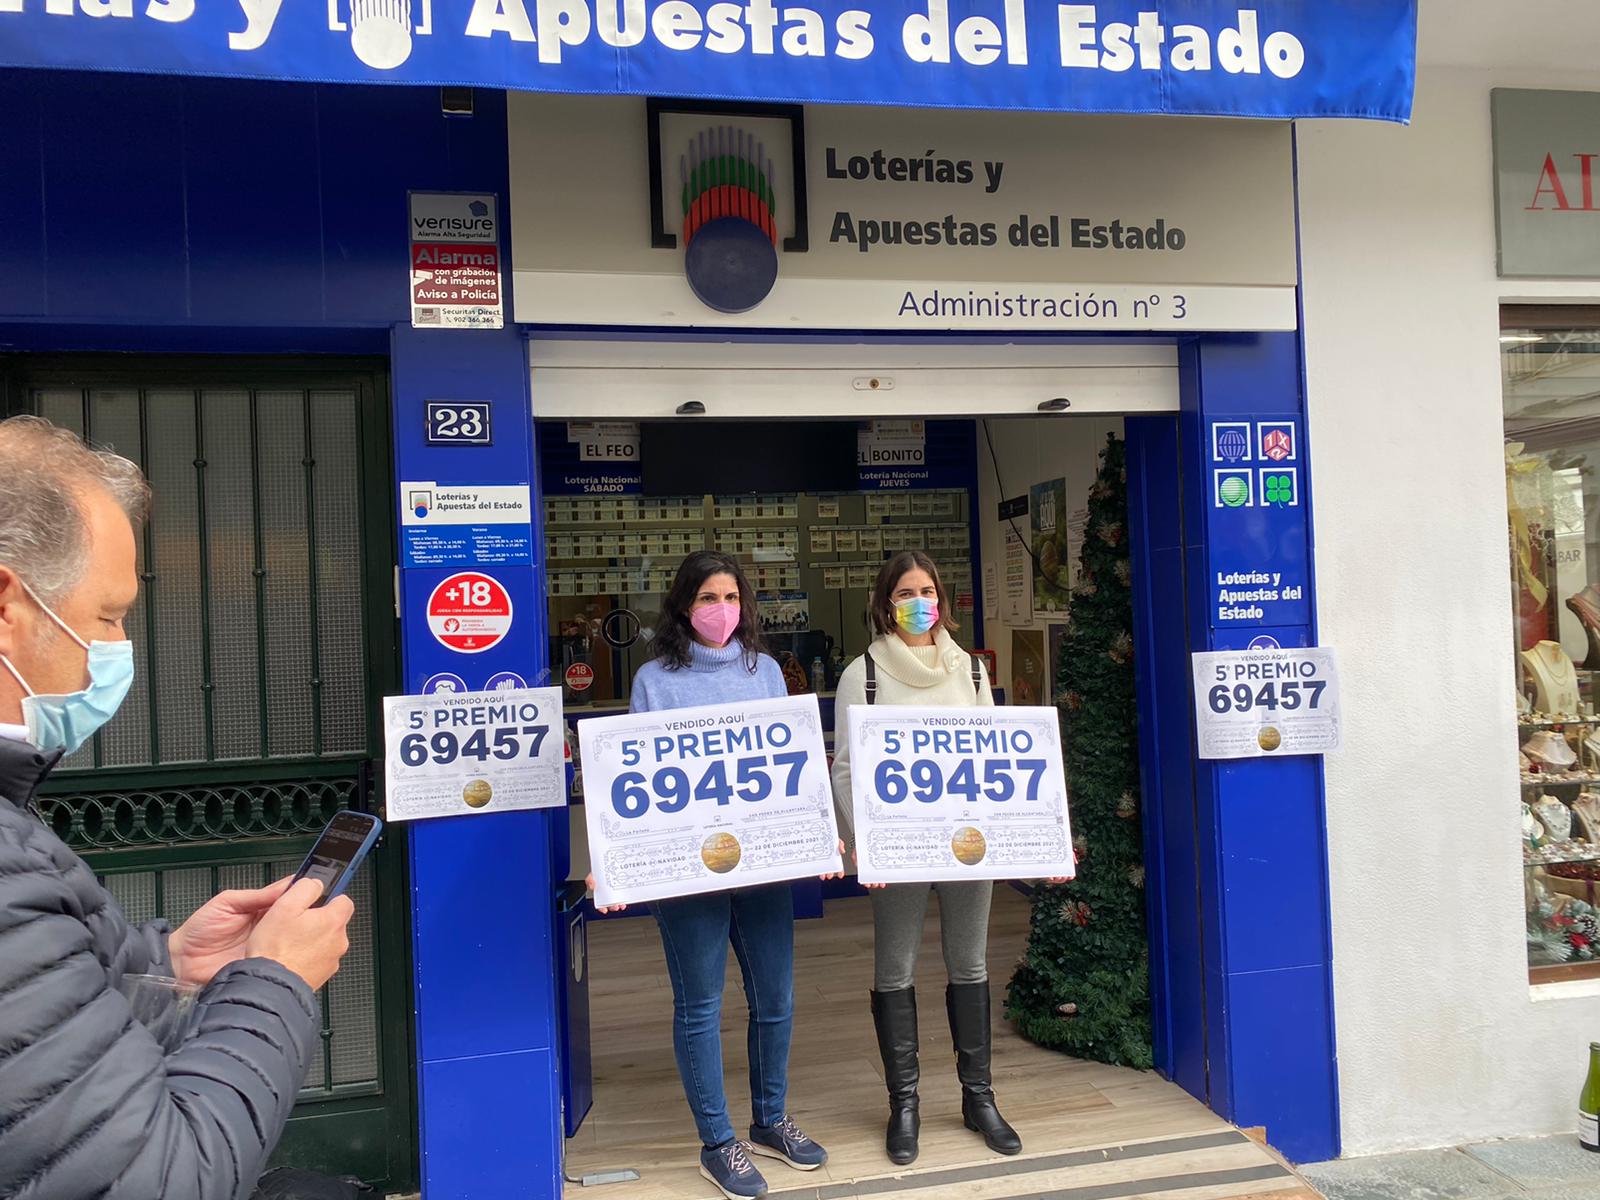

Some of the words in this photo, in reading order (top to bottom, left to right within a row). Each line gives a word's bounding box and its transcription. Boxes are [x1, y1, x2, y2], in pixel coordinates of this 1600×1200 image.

[228, 0, 283, 51] y
[465, 0, 875, 64] Apuestas
[902, 0, 1029, 66] del
[1058, 4, 1305, 79] Estado
[826, 148, 974, 184] Loterías
[984, 161, 1004, 194] y
[414, 217, 494, 230] verisure
[458, 231, 491, 239] Seguridad
[829, 212, 998, 253] Apuestas
[1008, 215, 1060, 248] del
[1071, 217, 1186, 251] Estado
[415, 248, 496, 265] Alarma
[434, 268, 451, 276] con
[452, 267, 496, 278] grabación
[435, 276, 448, 285] de
[450, 276, 497, 287] imágenes
[417, 289, 448, 299] Aviso
[451, 291, 458, 299] a
[461, 289, 497, 299] Policía
[898, 290, 1118, 318] Administración
[1172, 295, 1186, 319] 3
[435, 408, 483, 437] 23
[586, 444, 601, 457] EL
[606, 444, 634, 457] FEO
[872, 449, 923, 462] BONITO
[564, 475, 599, 485] Lotería
[601, 475, 642, 484] Nacional
[859, 471, 890, 480] Lotería
[892, 470, 929, 479] Nacional
[584, 482, 624, 493] SÁBADO
[879, 479, 910, 487] JUEVES
[435, 493, 471, 502] Loterías
[473, 494, 479, 502] y
[436, 502, 476, 512] Apuestas
[478, 501, 492, 510] del
[493, 501, 523, 510] Estado
[1558, 550, 1581, 563] BAR
[1217, 569, 1270, 585] Loterías
[1273, 571, 1281, 586] y
[445, 581, 492, 607] +18
[1219, 588, 1279, 604] Apuestas
[1282, 586, 1302, 600] del
[1218, 605, 1264, 620] Estado
[1240, 654, 1270, 662] VENDIDO
[1271, 653, 1288, 661] AQUÍ
[1234, 661, 1317, 680] PREMIO
[443, 696, 482, 706] VENDIDO
[483, 696, 505, 704] AQUÍ
[1208, 680, 1327, 714] 69457
[434, 703, 539, 728] PREMIO
[664, 718, 715, 732] VENDIDO
[718, 713, 745, 726] AQUÍ
[922, 717, 966, 726] VENDIDO
[968, 716, 993, 727] AQUÍ
[400, 725, 550, 767] 69457
[654, 722, 792, 763] PREMIO
[912, 729, 1034, 755] PREMIO
[611, 750, 809, 819] 69457
[874, 758, 1048, 804] 69457
[773, 839, 804, 849] DICIEMBRE
[619, 861, 647, 869] LOTERÍA
[657, 855, 686, 865] NAVIDAD
